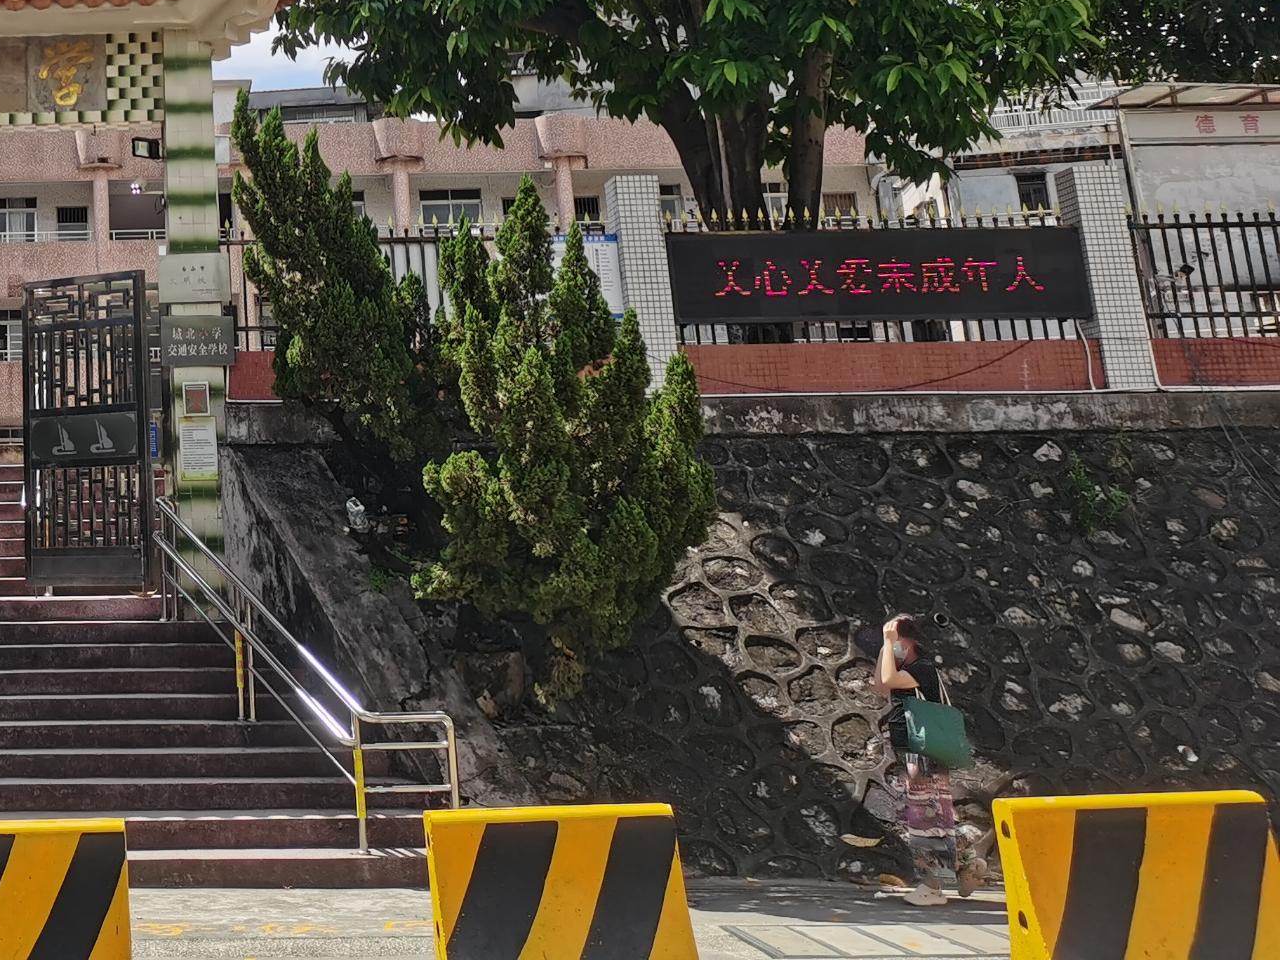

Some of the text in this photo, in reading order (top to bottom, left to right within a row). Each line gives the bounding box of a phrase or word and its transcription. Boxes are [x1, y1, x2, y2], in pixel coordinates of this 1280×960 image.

[1194, 114, 1260, 135] 德育
[167, 342, 228, 357] 交通安全学校
